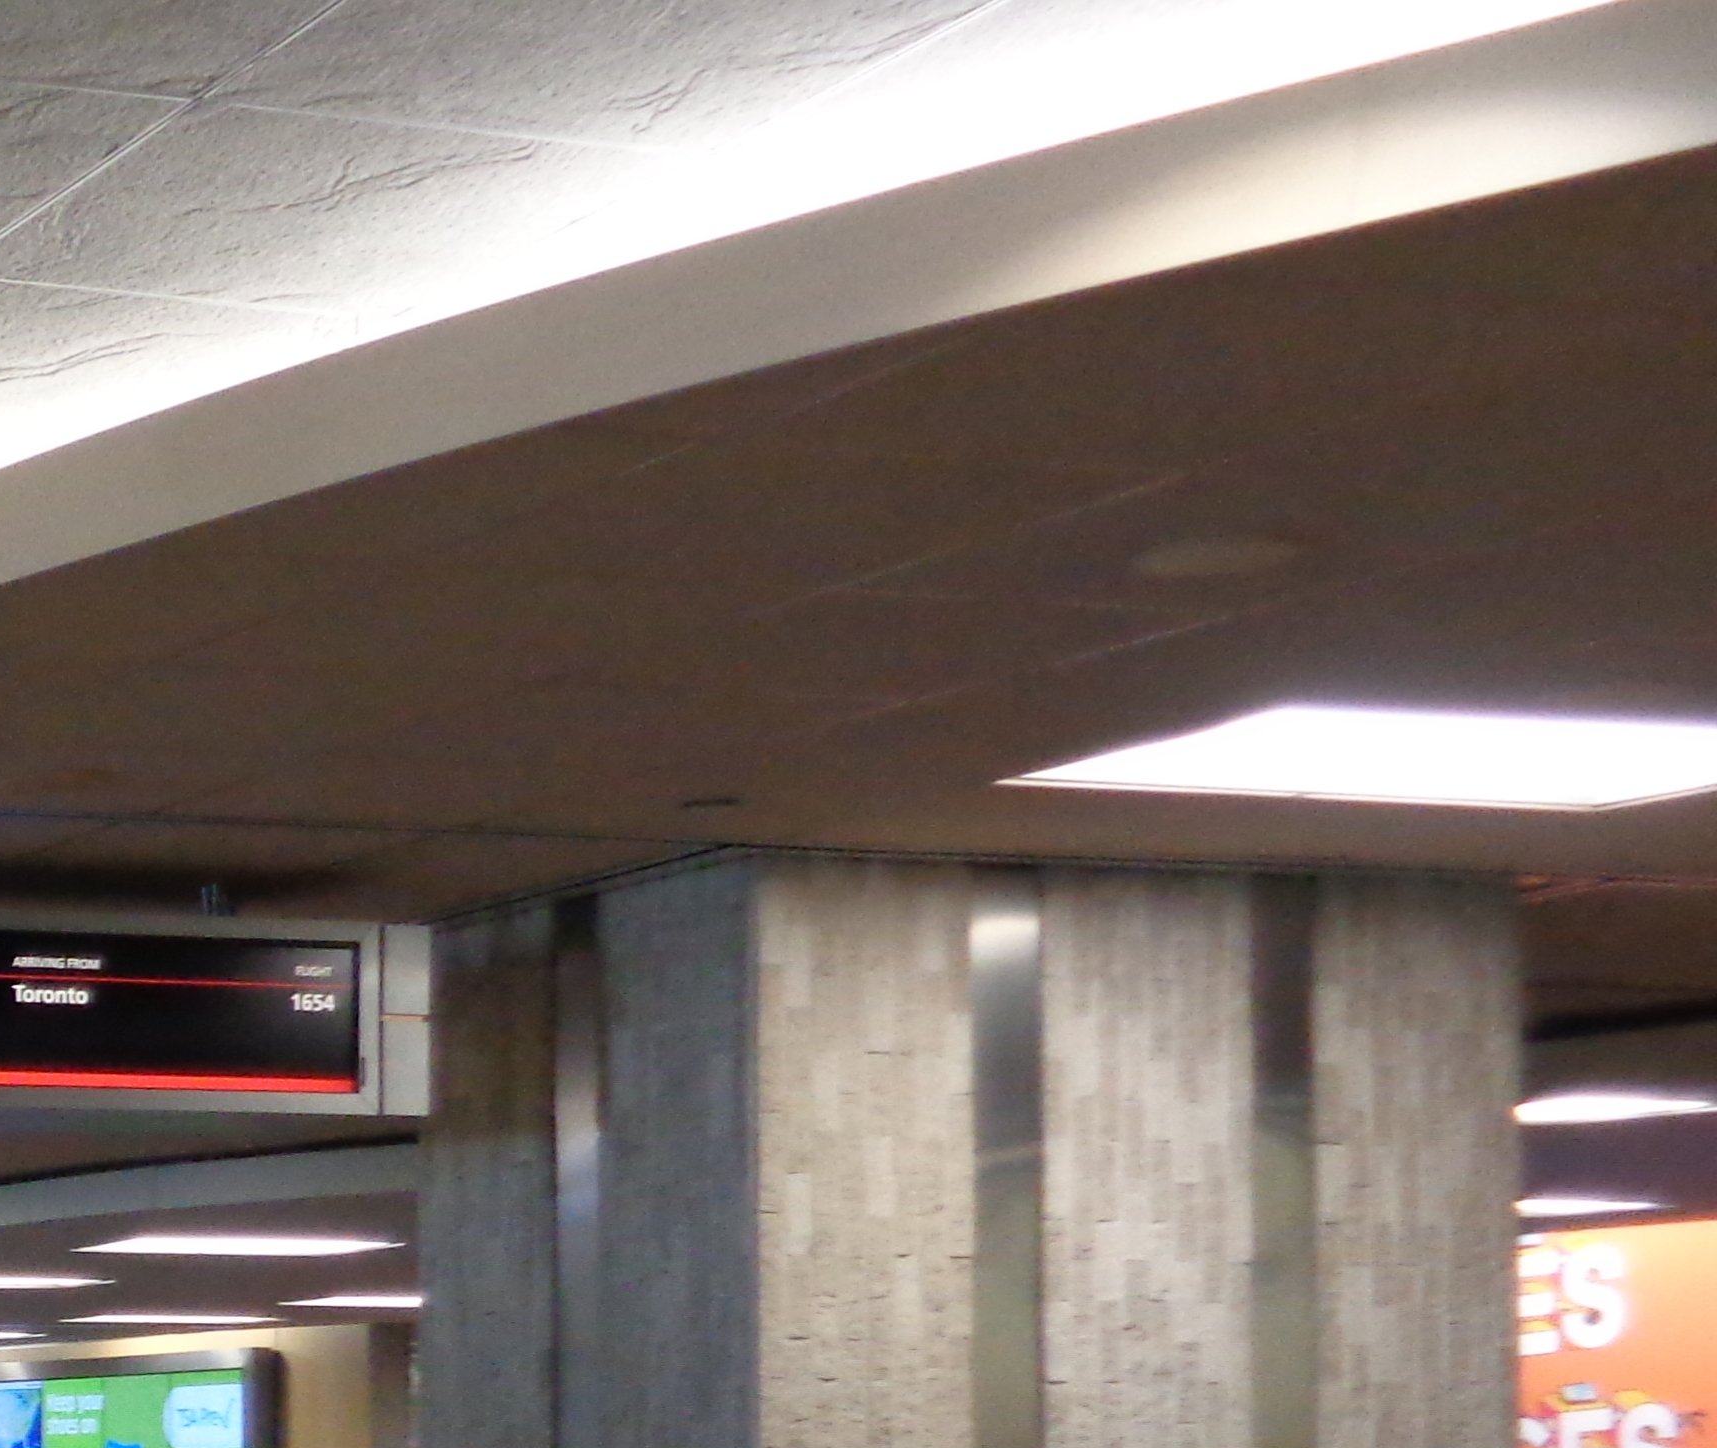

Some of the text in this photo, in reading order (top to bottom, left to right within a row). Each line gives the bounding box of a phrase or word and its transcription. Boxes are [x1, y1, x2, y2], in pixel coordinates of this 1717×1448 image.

[12, 955, 102, 970] ARRIVING FROM
[294, 965, 333, 978] FLIGHT
[11, 983, 89, 1005] Toronto
[290, 993, 336, 1013] 1654
